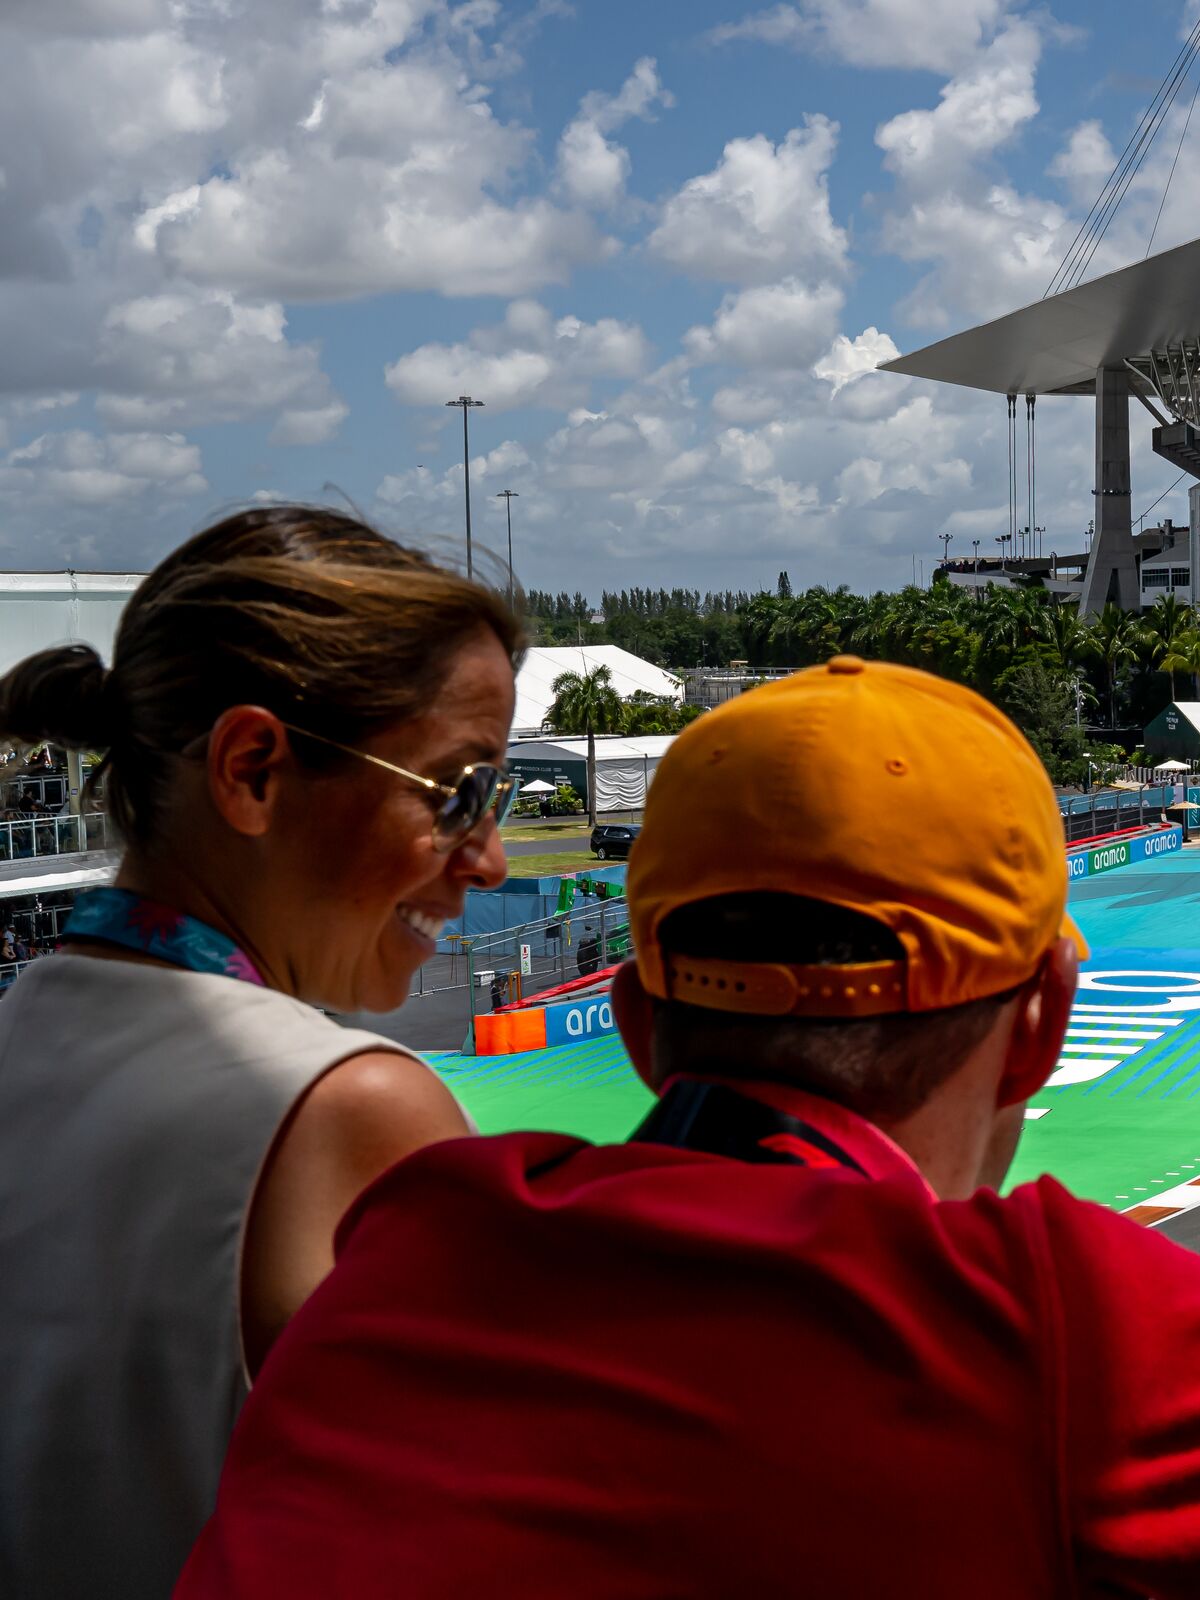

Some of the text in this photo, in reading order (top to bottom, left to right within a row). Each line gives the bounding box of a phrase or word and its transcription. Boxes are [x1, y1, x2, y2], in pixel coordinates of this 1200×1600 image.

[1145, 833, 1177, 855] aramco
[1094, 846, 1127, 870] aramco
[565, 1002, 614, 1036] ara
